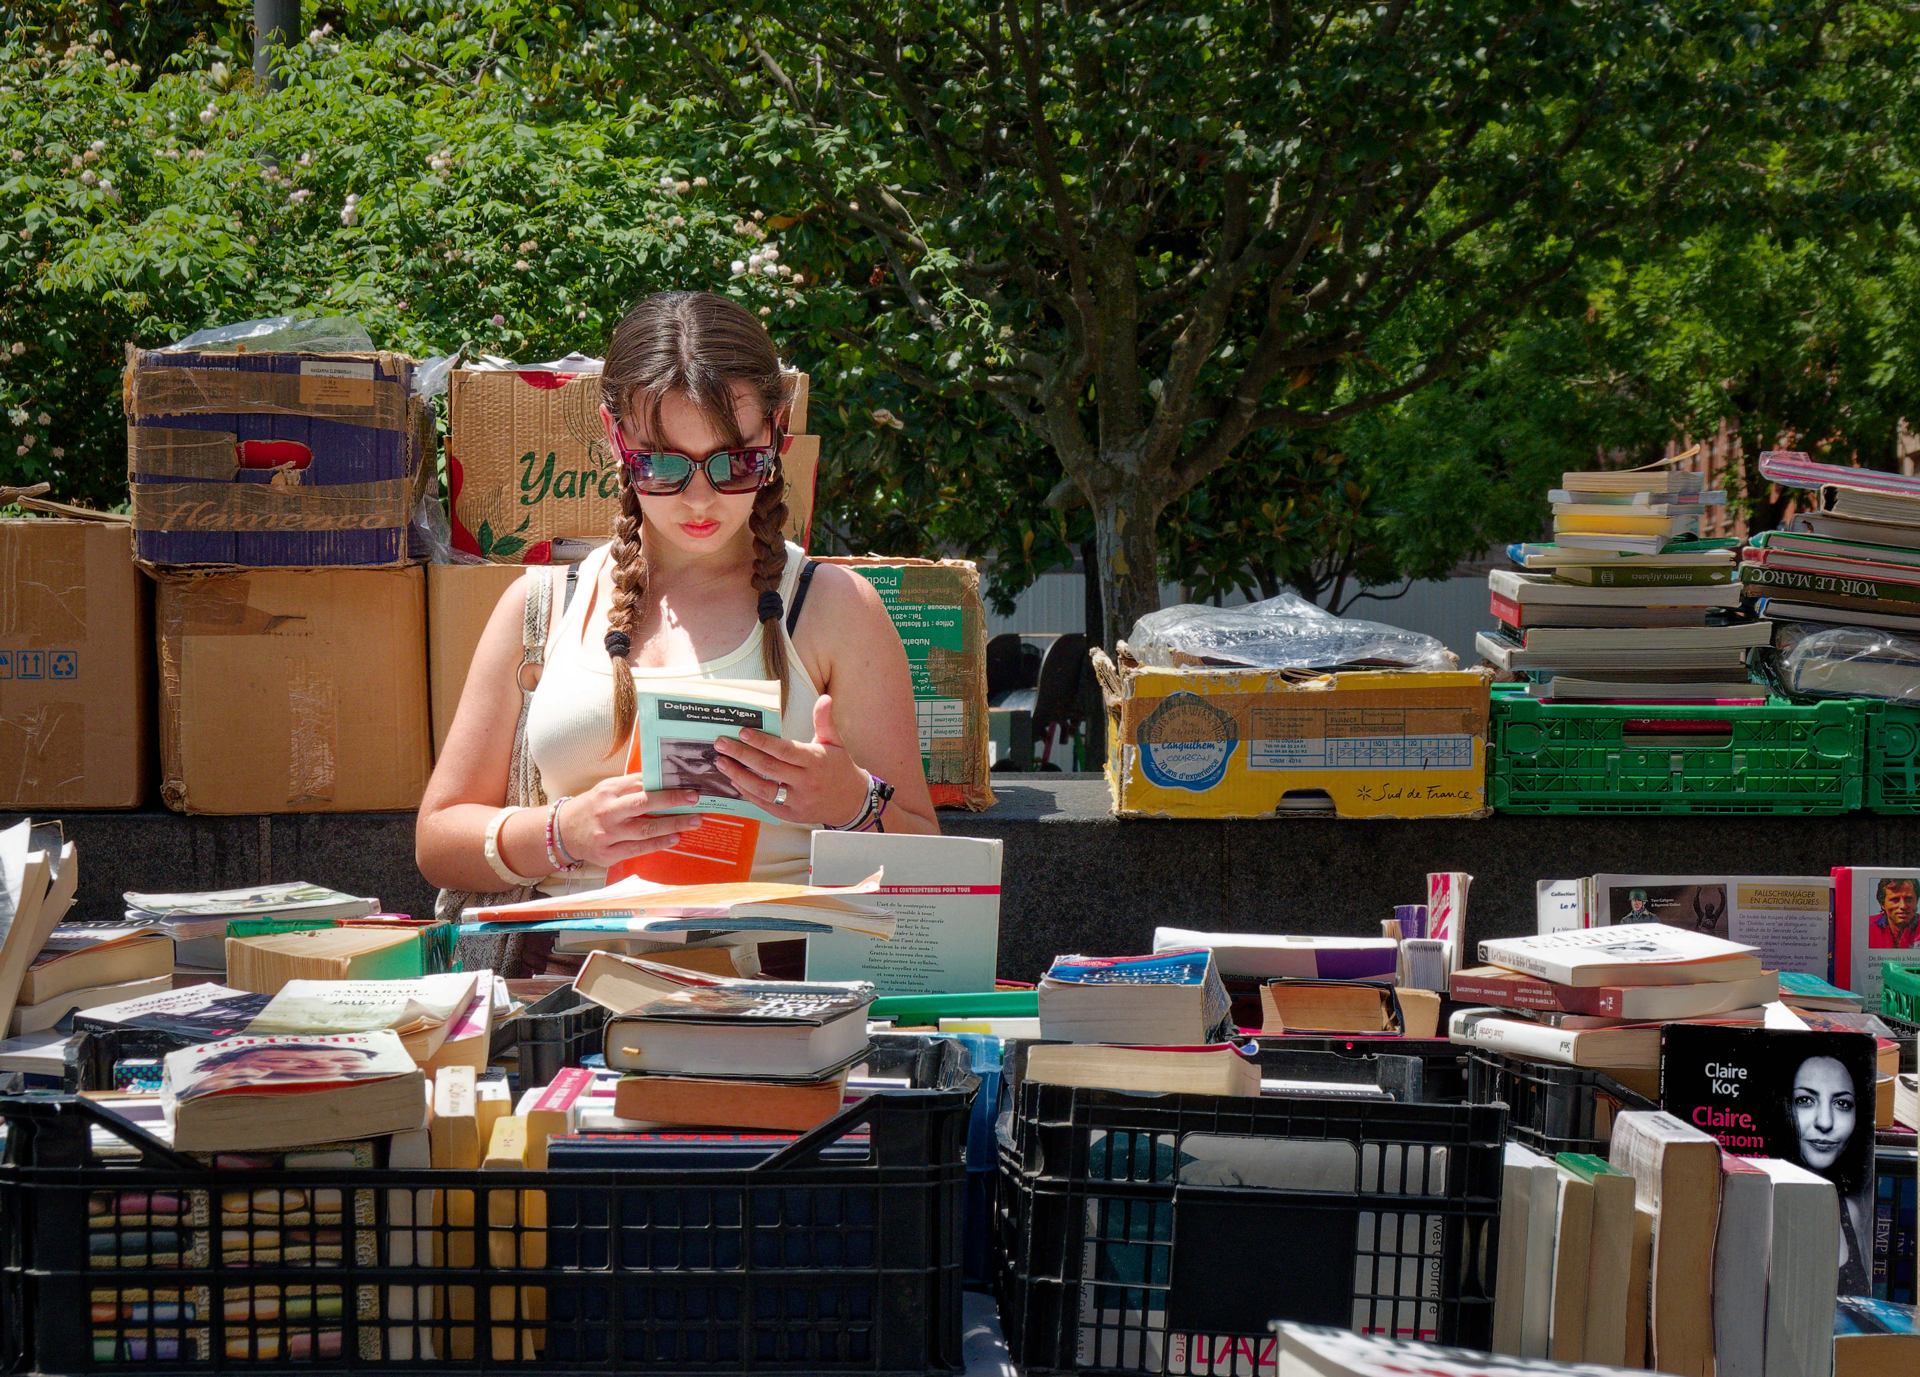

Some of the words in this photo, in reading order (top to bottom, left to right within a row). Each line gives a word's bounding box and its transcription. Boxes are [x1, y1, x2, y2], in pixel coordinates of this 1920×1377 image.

[162, 500, 388, 530] flamenco
[1750, 568, 1812, 588] MAROC
[1815, 576, 1837, 591] LE
[1841, 579, 1878, 597] VOIR
[664, 702, 710, 713] Delphine
[713, 706, 726, 714] de
[728, 708, 756, 718] Vigan
[1162, 740, 1215, 752] Canguilhem
[1158, 759, 1168, 770] 70
[1166, 768, 1177, 777] ans
[1372, 783, 1403, 801] Sud
[1406, 788, 1421, 799] de
[1426, 784, 1472, 800] France
[1760, 897, 1790, 905] ACTION
[573, 910, 598, 918] cahiers
[196, 1036, 369, 1054] COLUCHE
[1705, 1062, 1748, 1079] Claire
[1712, 1079, 1740, 1098] Koç
[1692, 1106, 1757, 1131] Claire,
[1716, 1131, 1764, 1149] rénom
[1874, 1217, 1892, 1276] TEMPTE
[1175, 1333, 1186, 1363] erre
